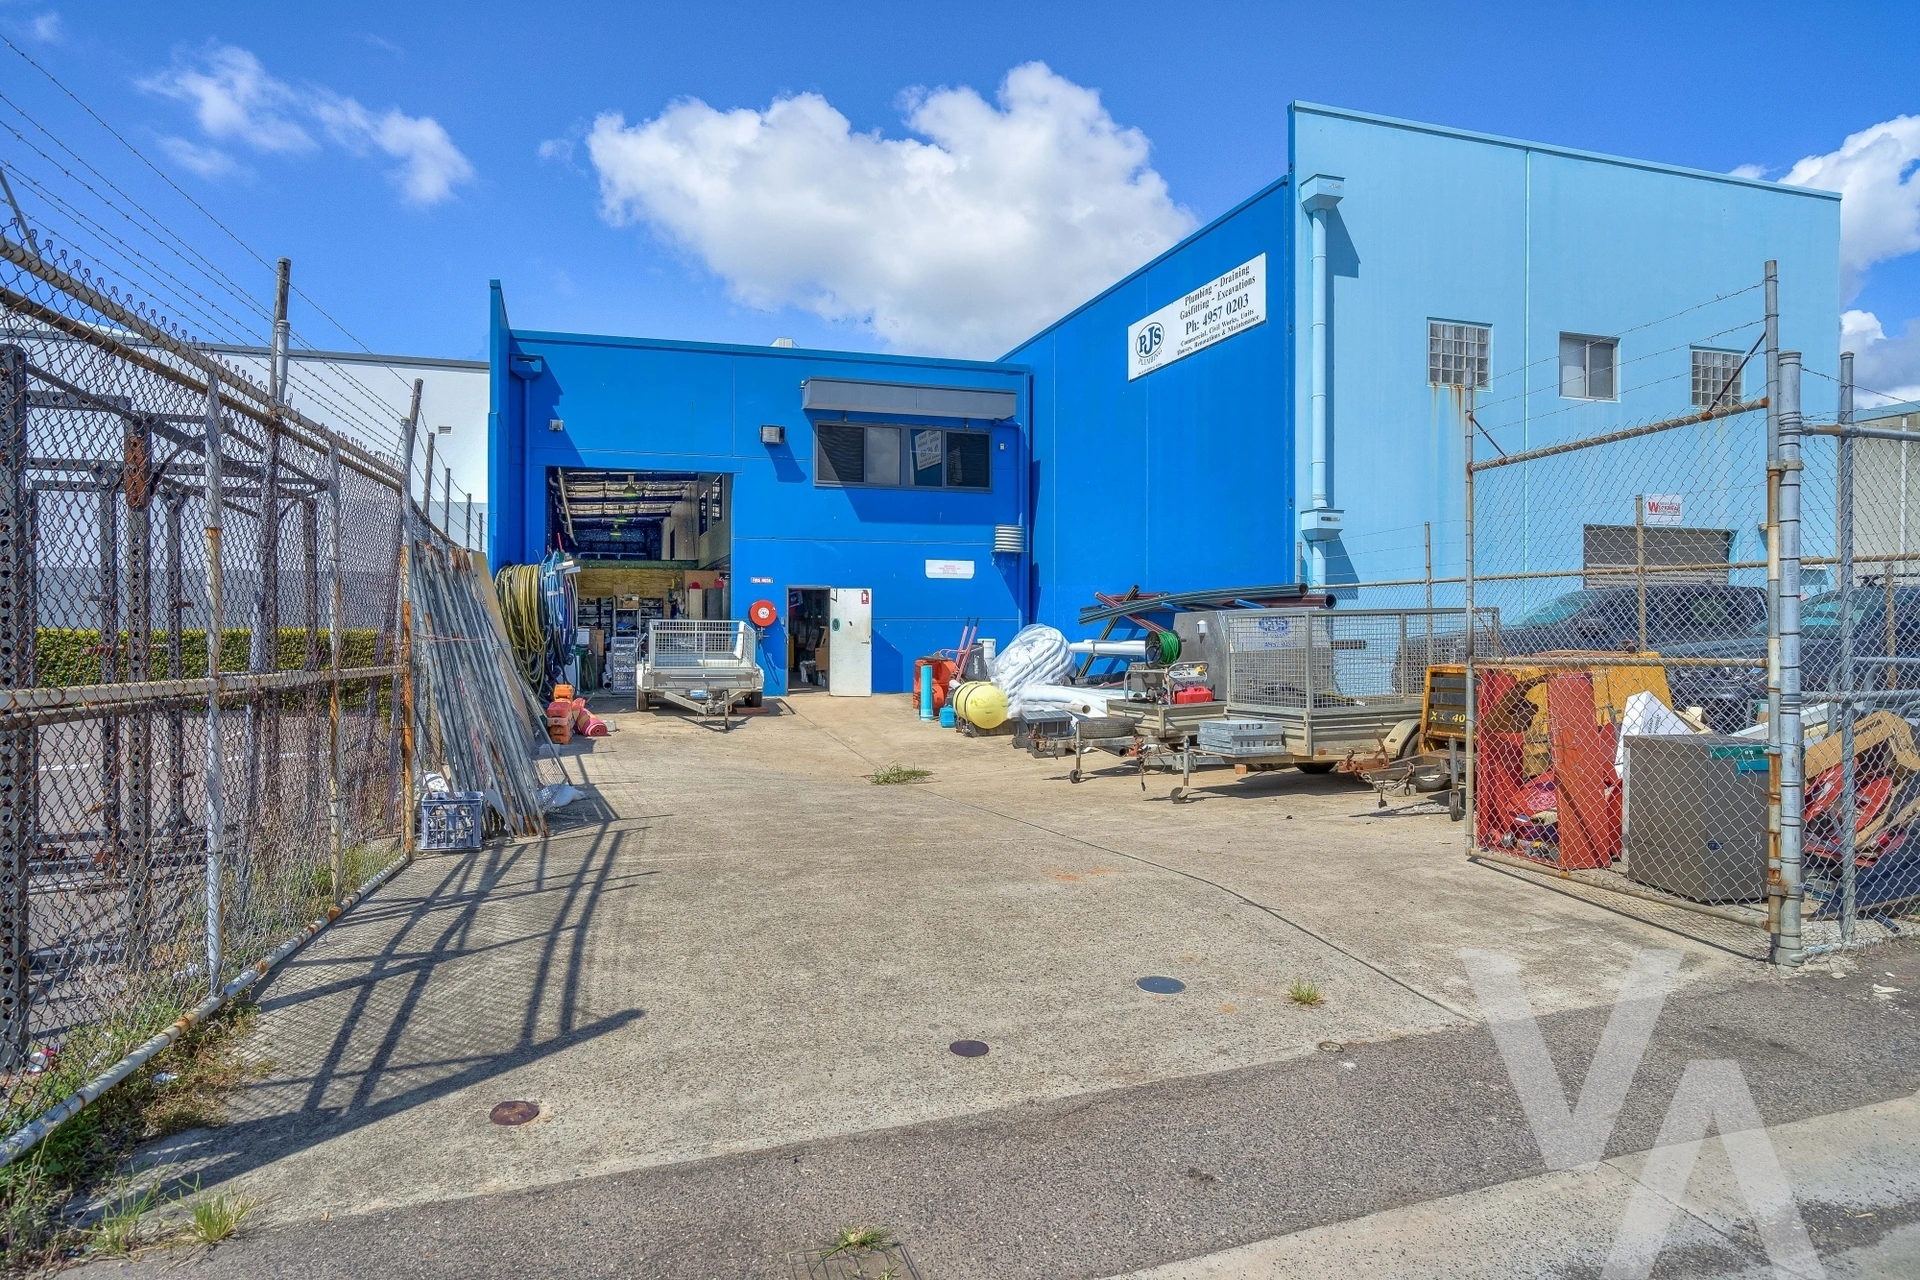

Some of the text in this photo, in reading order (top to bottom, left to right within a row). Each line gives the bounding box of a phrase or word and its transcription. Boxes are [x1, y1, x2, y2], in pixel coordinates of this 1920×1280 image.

[1180, 298, 1210, 321] Gasfitting
[1217, 275, 1256, 302] Excavations
[1184, 285, 1213, 307] Plumbing
[1220, 265, 1250, 288] Draining
[1185, 292, 1249, 336] Ph: 4957 0203
[1194, 332, 1221, 349] Renovations
[1227, 314, 1260, 333] Maintenance
[1240, 308, 1255, 320] Units
